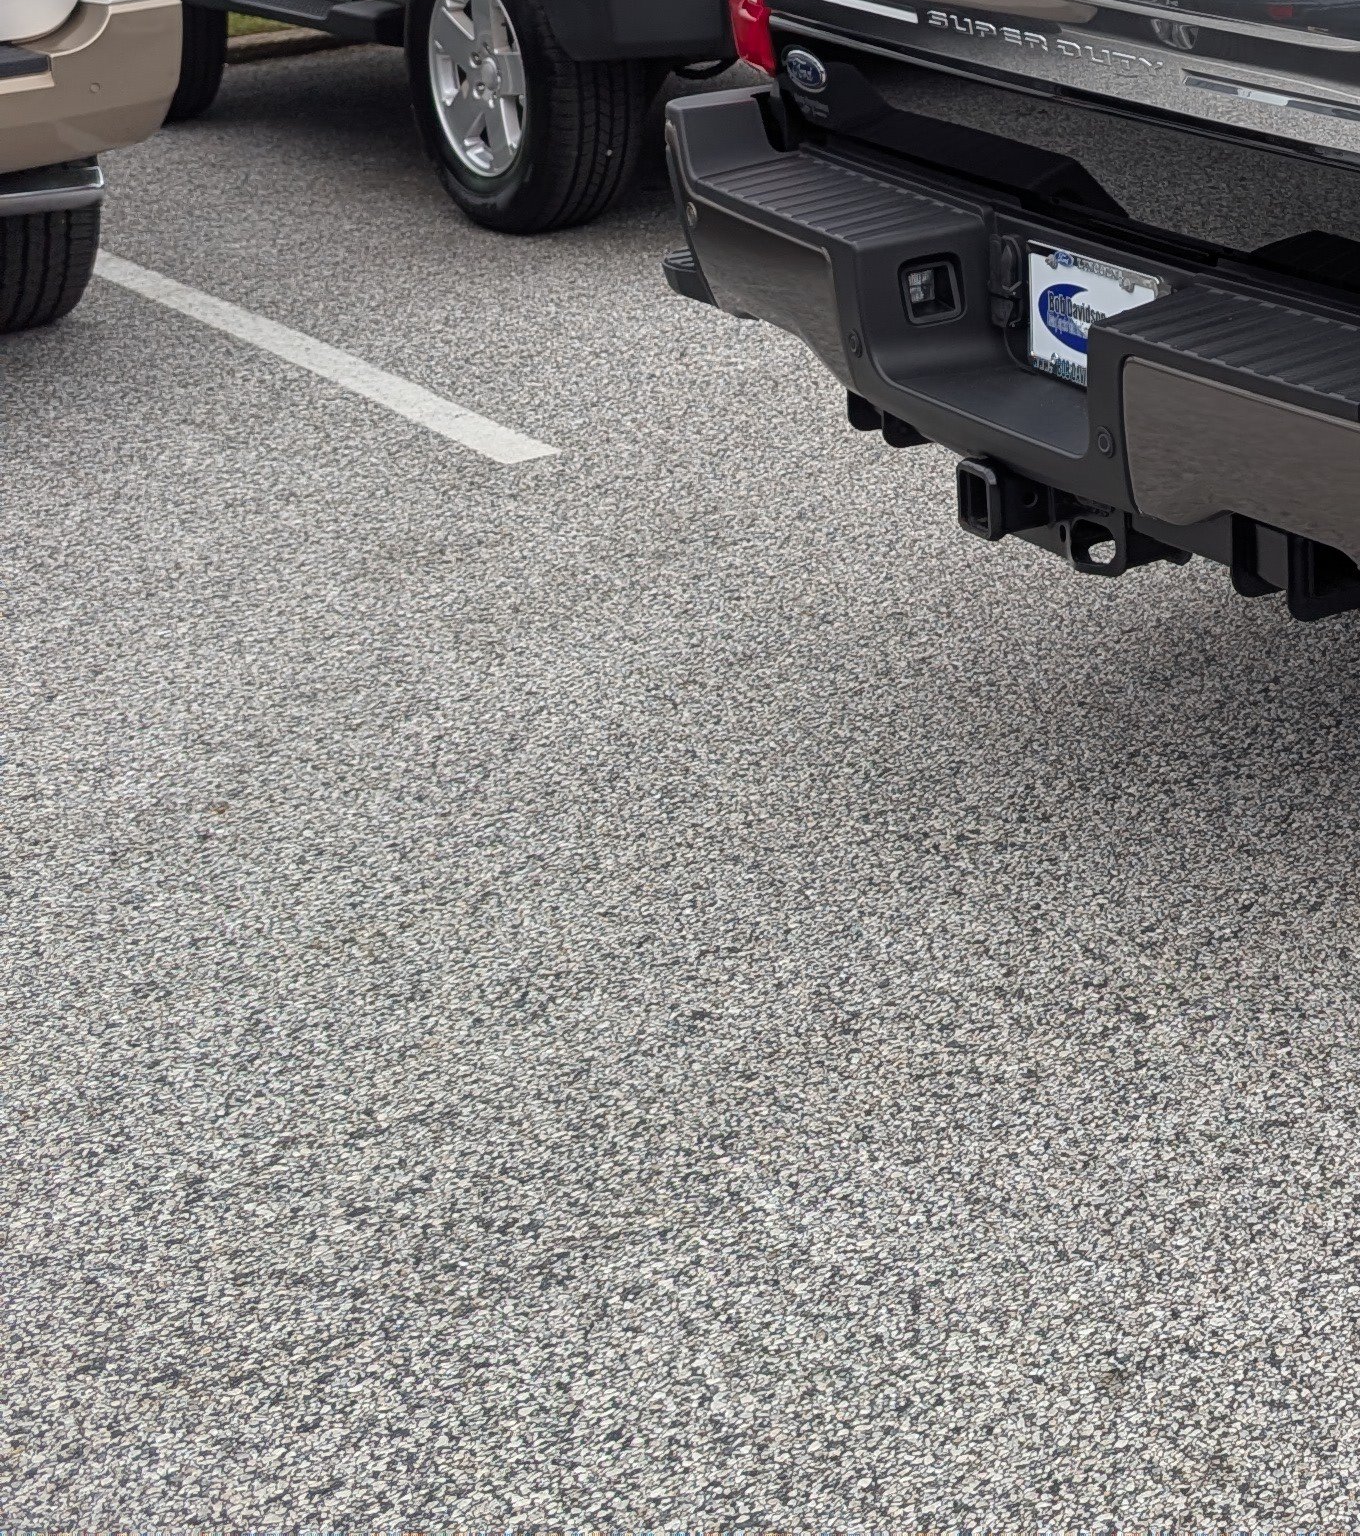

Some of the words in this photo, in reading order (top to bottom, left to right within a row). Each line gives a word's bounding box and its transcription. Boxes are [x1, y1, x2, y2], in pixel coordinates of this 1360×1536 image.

[927, 9, 1049, 53] SUPER
[1056, 38, 1164, 69] DUTY
[1047, 291, 1065, 317] Bob
